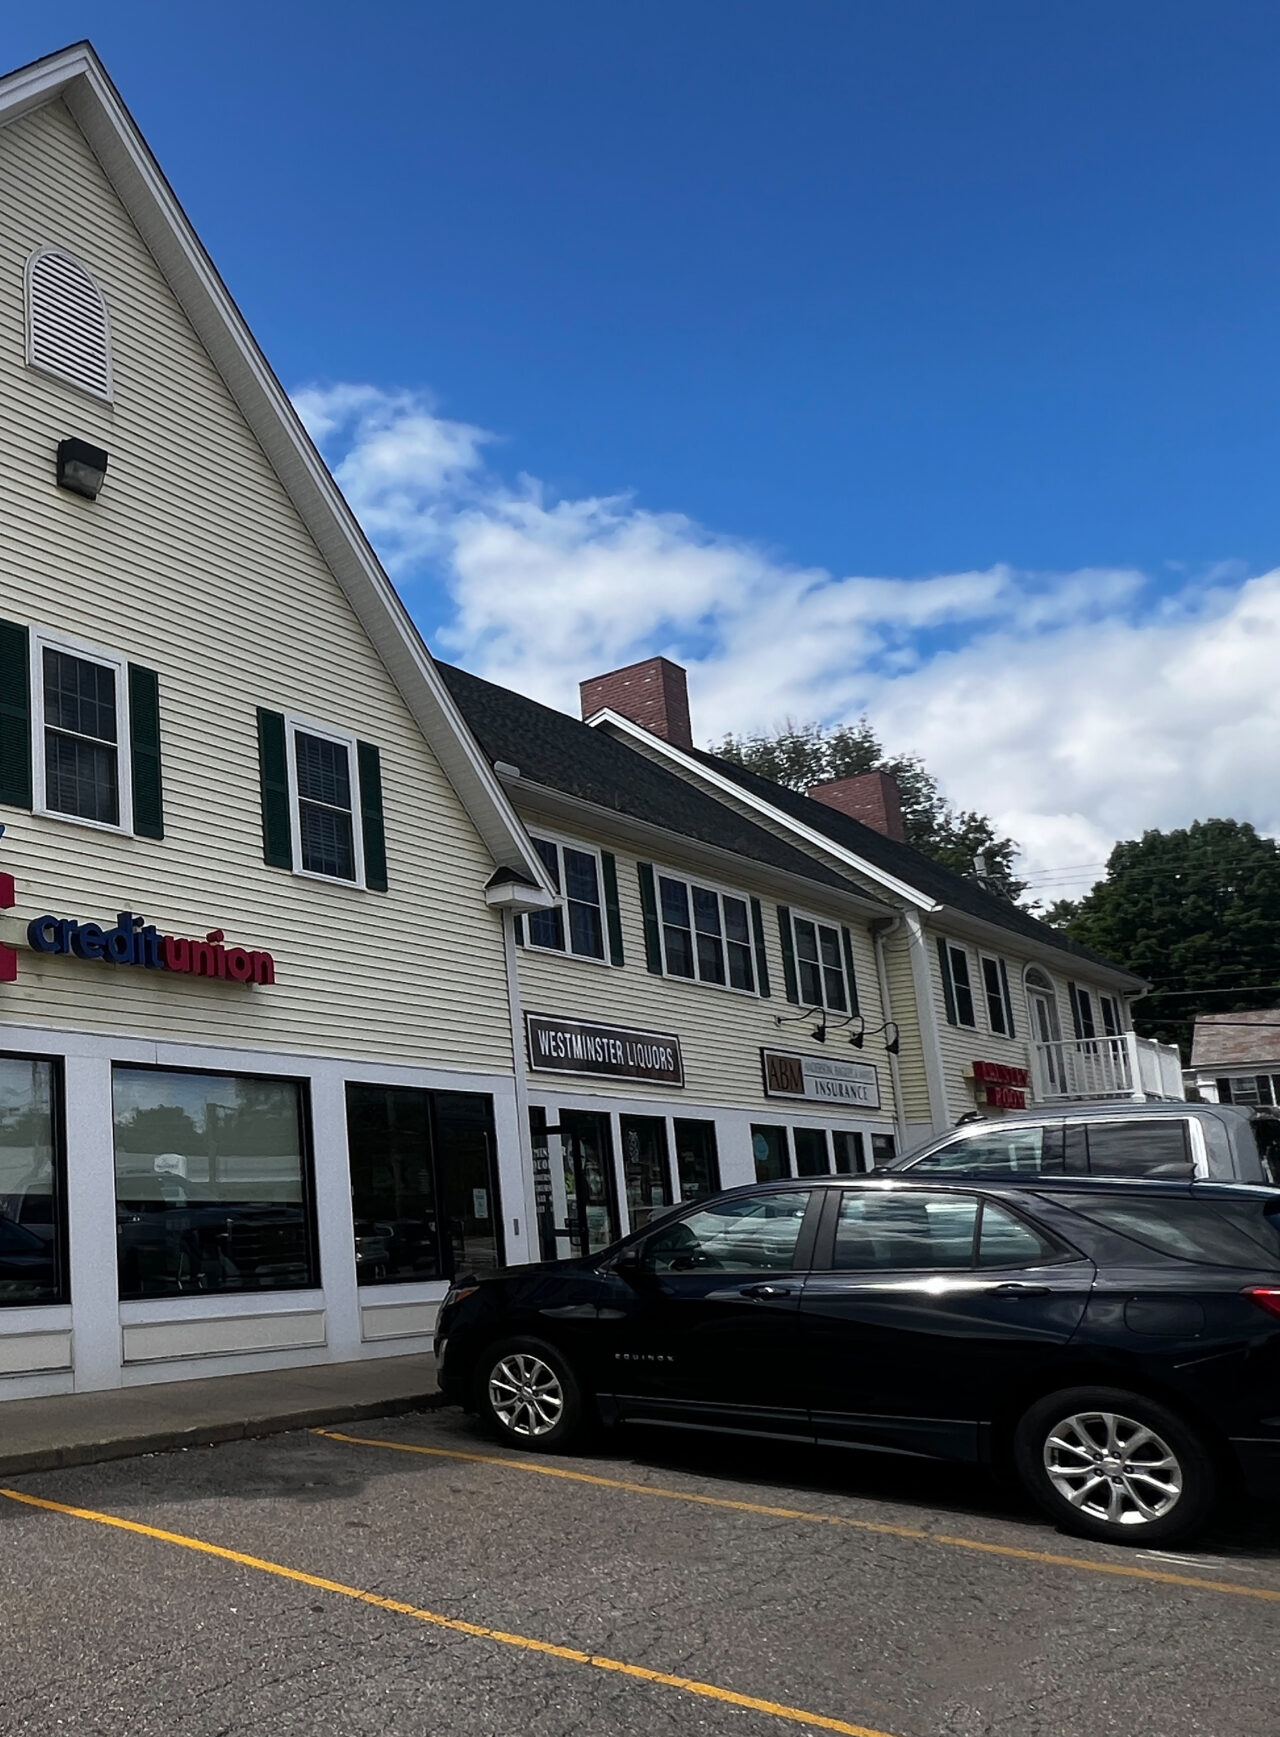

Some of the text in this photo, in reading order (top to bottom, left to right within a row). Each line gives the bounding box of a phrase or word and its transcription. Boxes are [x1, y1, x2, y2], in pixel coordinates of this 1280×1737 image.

[537, 1028, 674, 1072] WESTMINSTER LIQUORS
[768, 1057, 804, 1092] ABM
[814, 1079, 868, 1101] INSURANCE
[615, 1353, 674, 1362] EQUINOX
